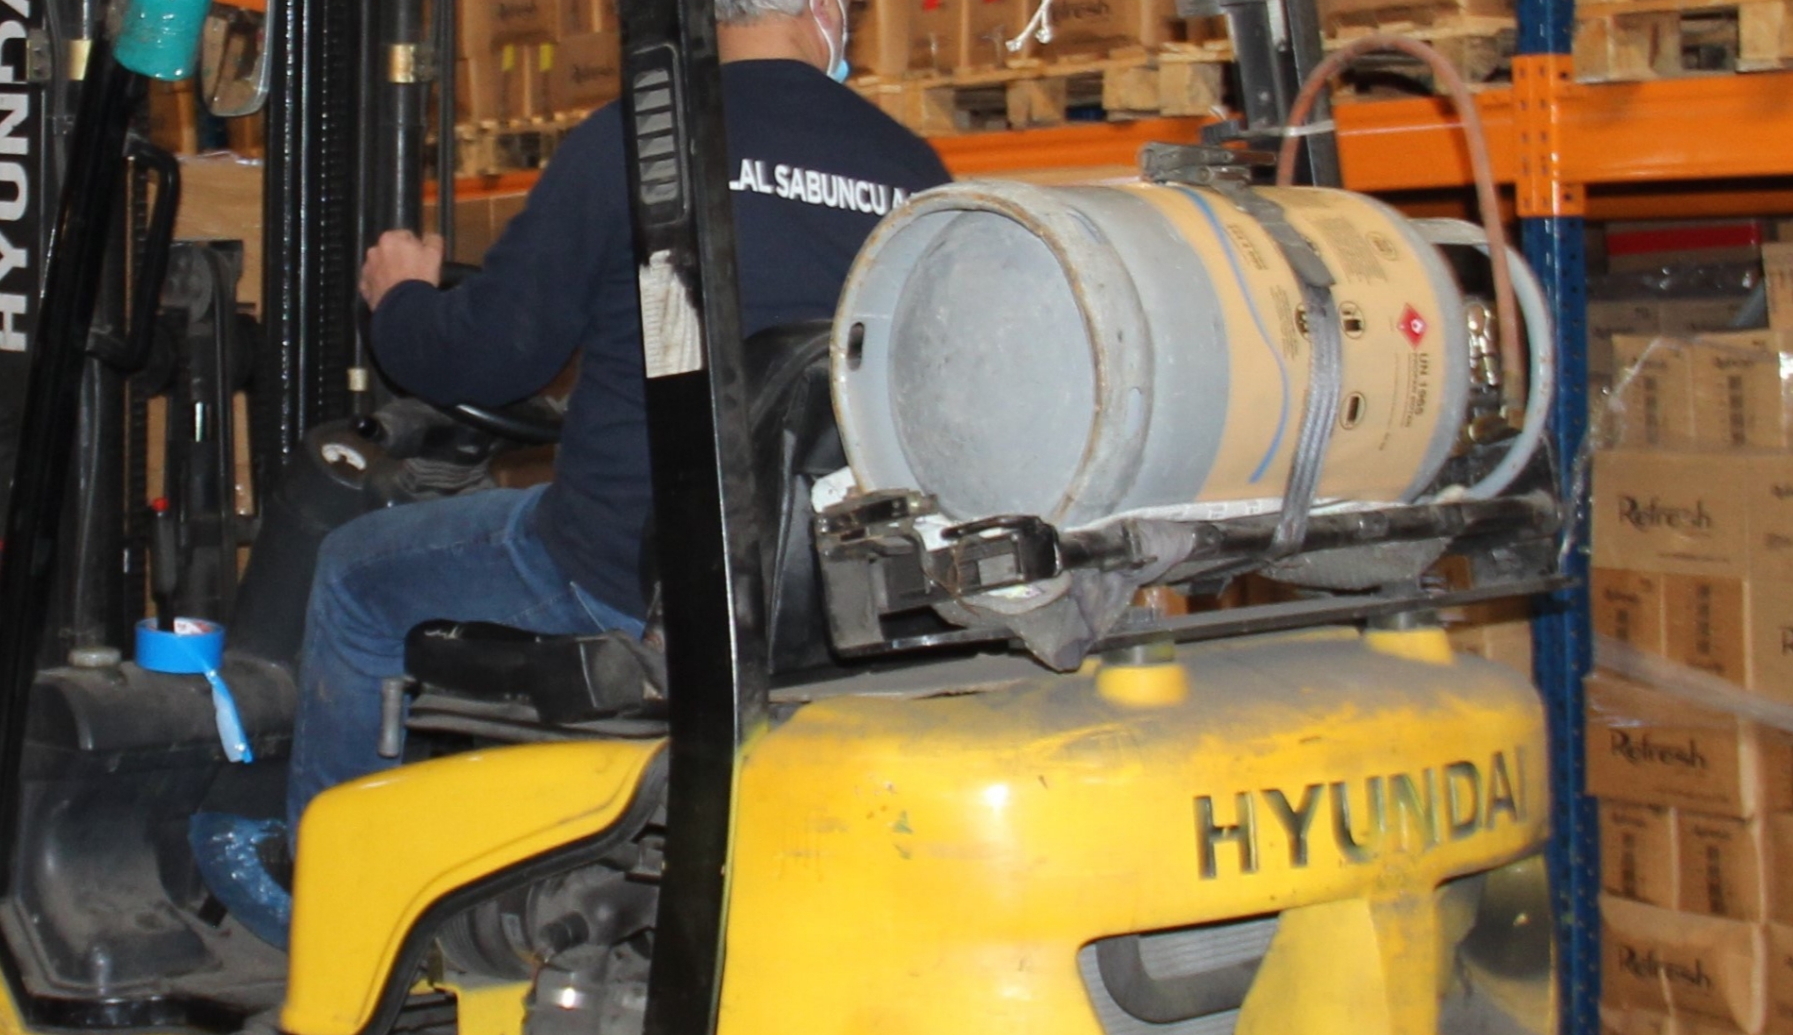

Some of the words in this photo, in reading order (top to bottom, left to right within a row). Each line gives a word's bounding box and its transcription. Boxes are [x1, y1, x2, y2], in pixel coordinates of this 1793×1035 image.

[774, 165, 886, 215] SABUNCU
[1617, 495, 1711, 532] Refresh
[1609, 727, 1707, 770] Refresh
[1194, 745, 1527, 881] HYUNDAI
[1616, 945, 1711, 991] Refresh
